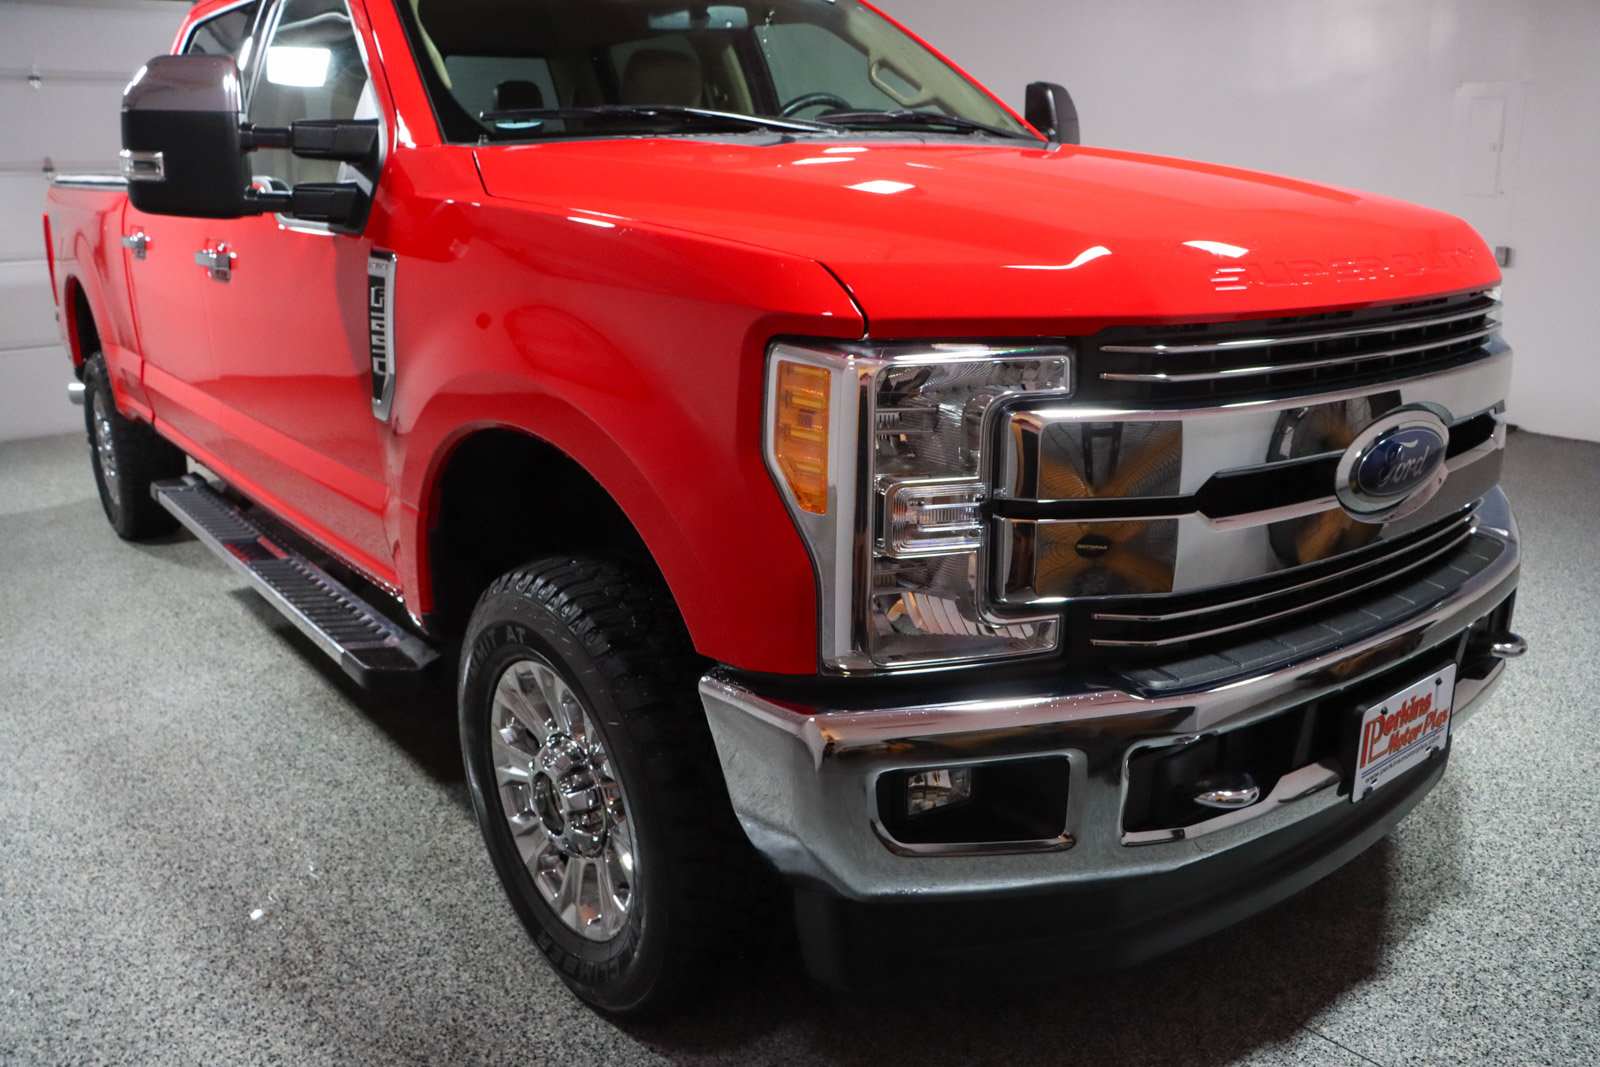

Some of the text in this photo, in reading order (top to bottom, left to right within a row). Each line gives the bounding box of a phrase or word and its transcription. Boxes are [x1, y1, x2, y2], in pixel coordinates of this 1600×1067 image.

[1378, 440, 1430, 487] Ford
[506, 625, 526, 644] AT
[1360, 692, 1432, 768] Perkins
[1388, 722, 1423, 754] Motor
